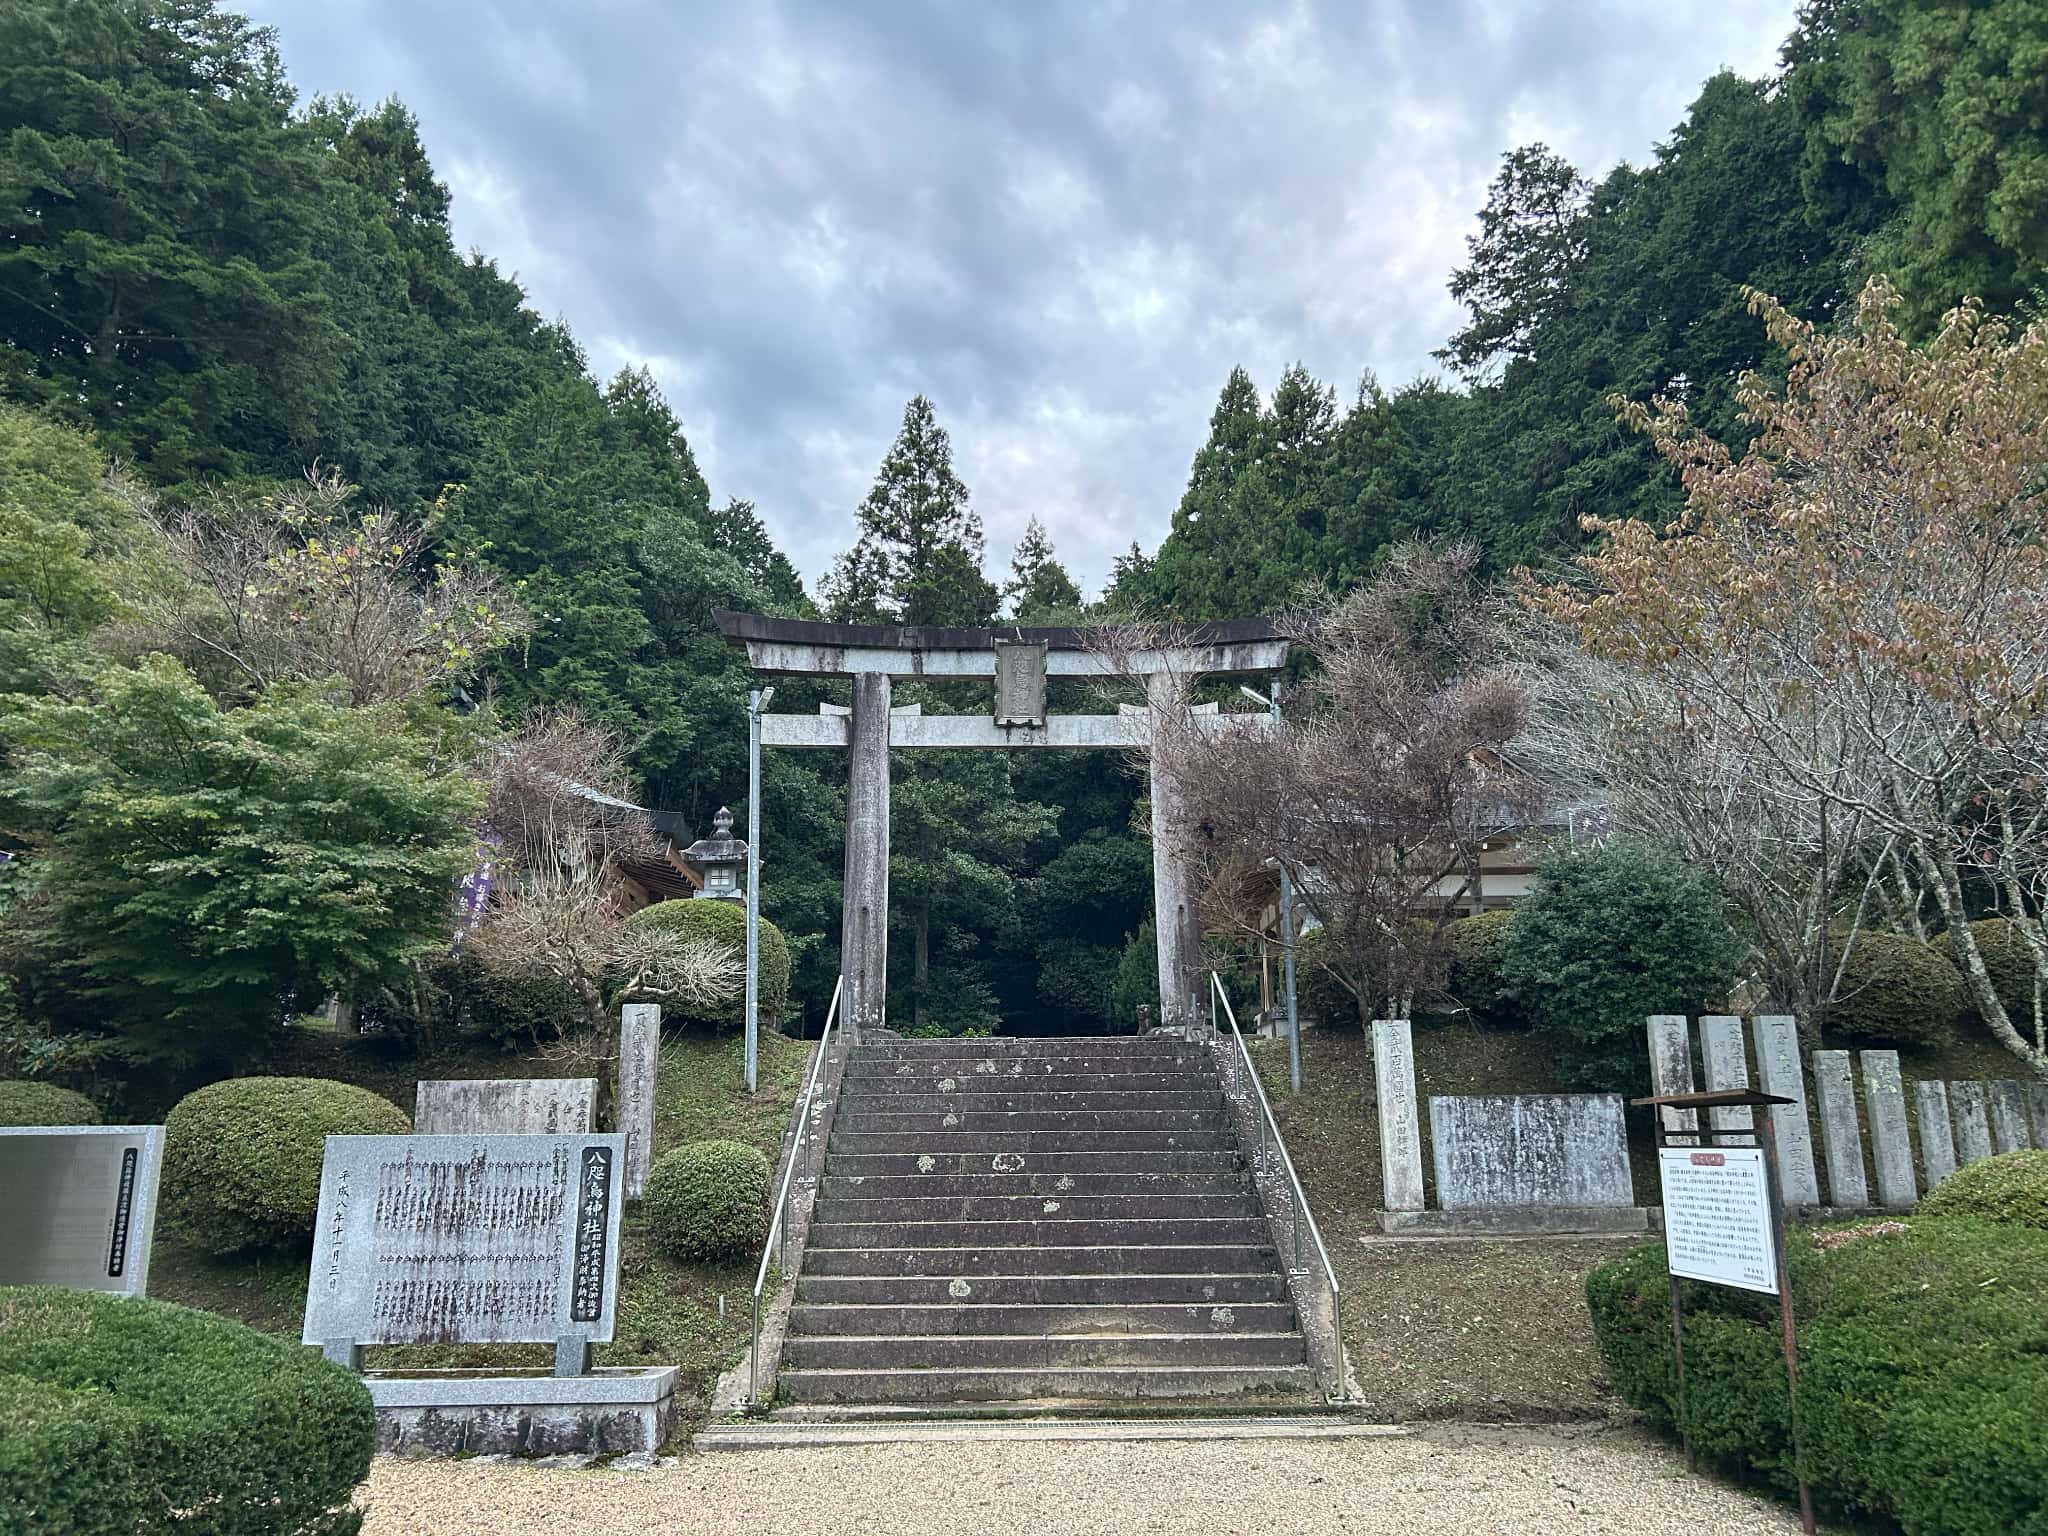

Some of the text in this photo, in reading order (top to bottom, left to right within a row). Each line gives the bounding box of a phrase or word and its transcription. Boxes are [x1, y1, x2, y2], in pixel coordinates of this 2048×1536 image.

[328, 1169, 351, 1291] 平成八年十一月三日
